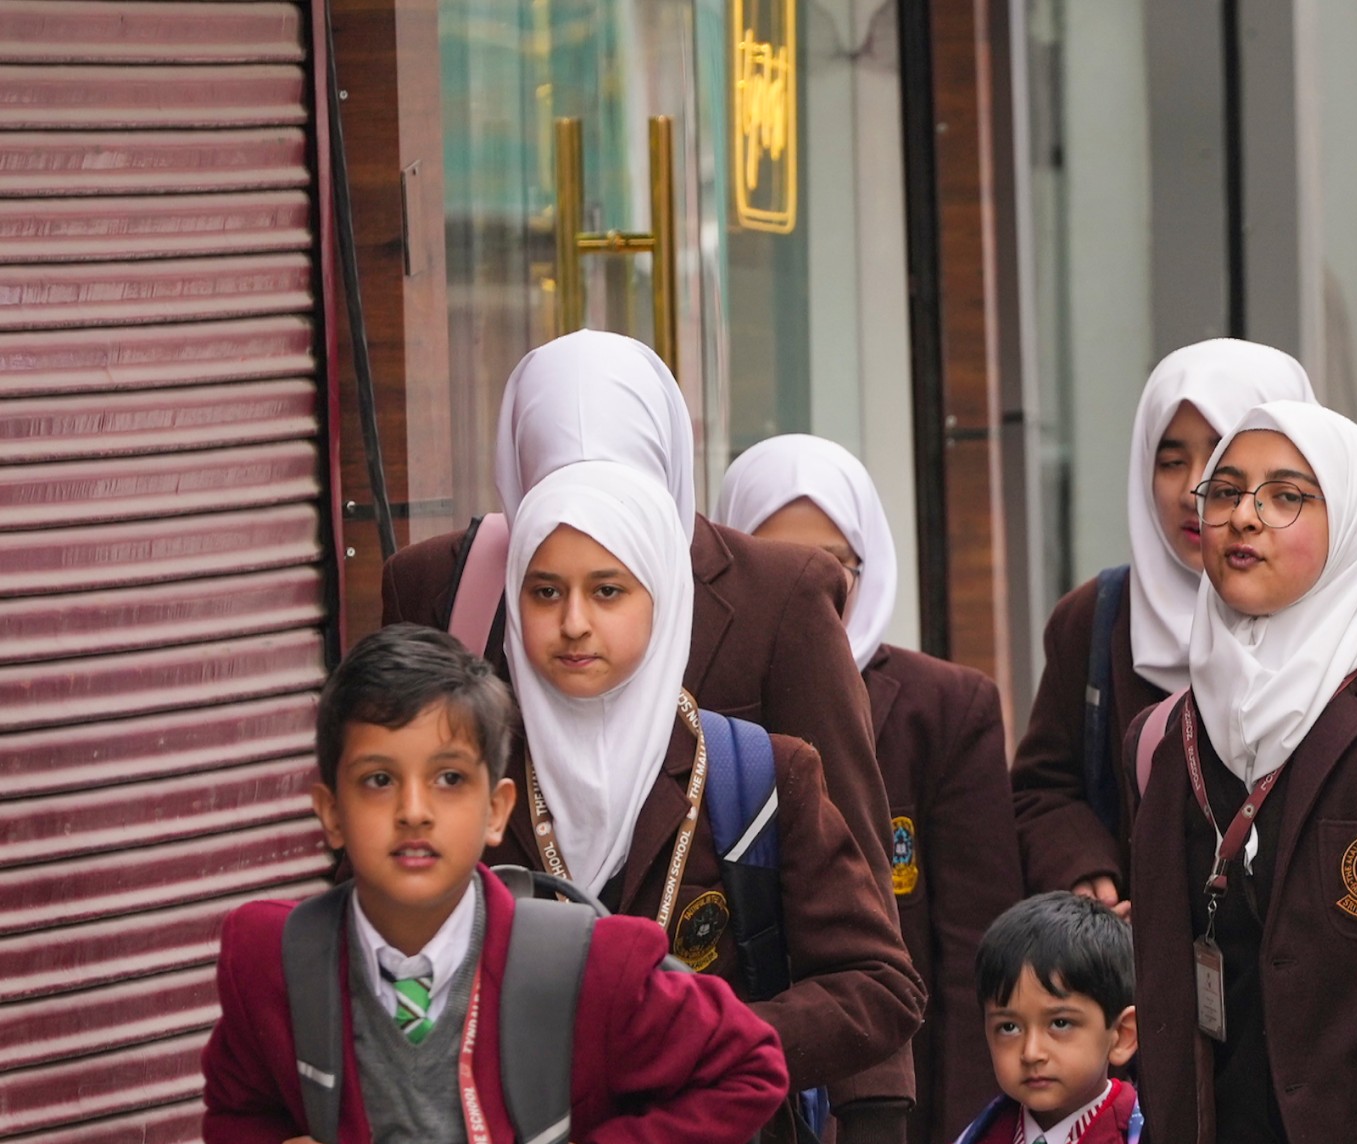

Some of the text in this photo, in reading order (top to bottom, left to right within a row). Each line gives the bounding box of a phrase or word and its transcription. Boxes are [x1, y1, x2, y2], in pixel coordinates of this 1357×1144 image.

[690, 776, 704, 799] THE
[1188, 745, 1201, 791] SCHOOL
[535, 786, 548, 817] THE
[658, 829, 692, 927] LLINSON SCHOOL
[464, 1086, 486, 1132] SCHOOL
